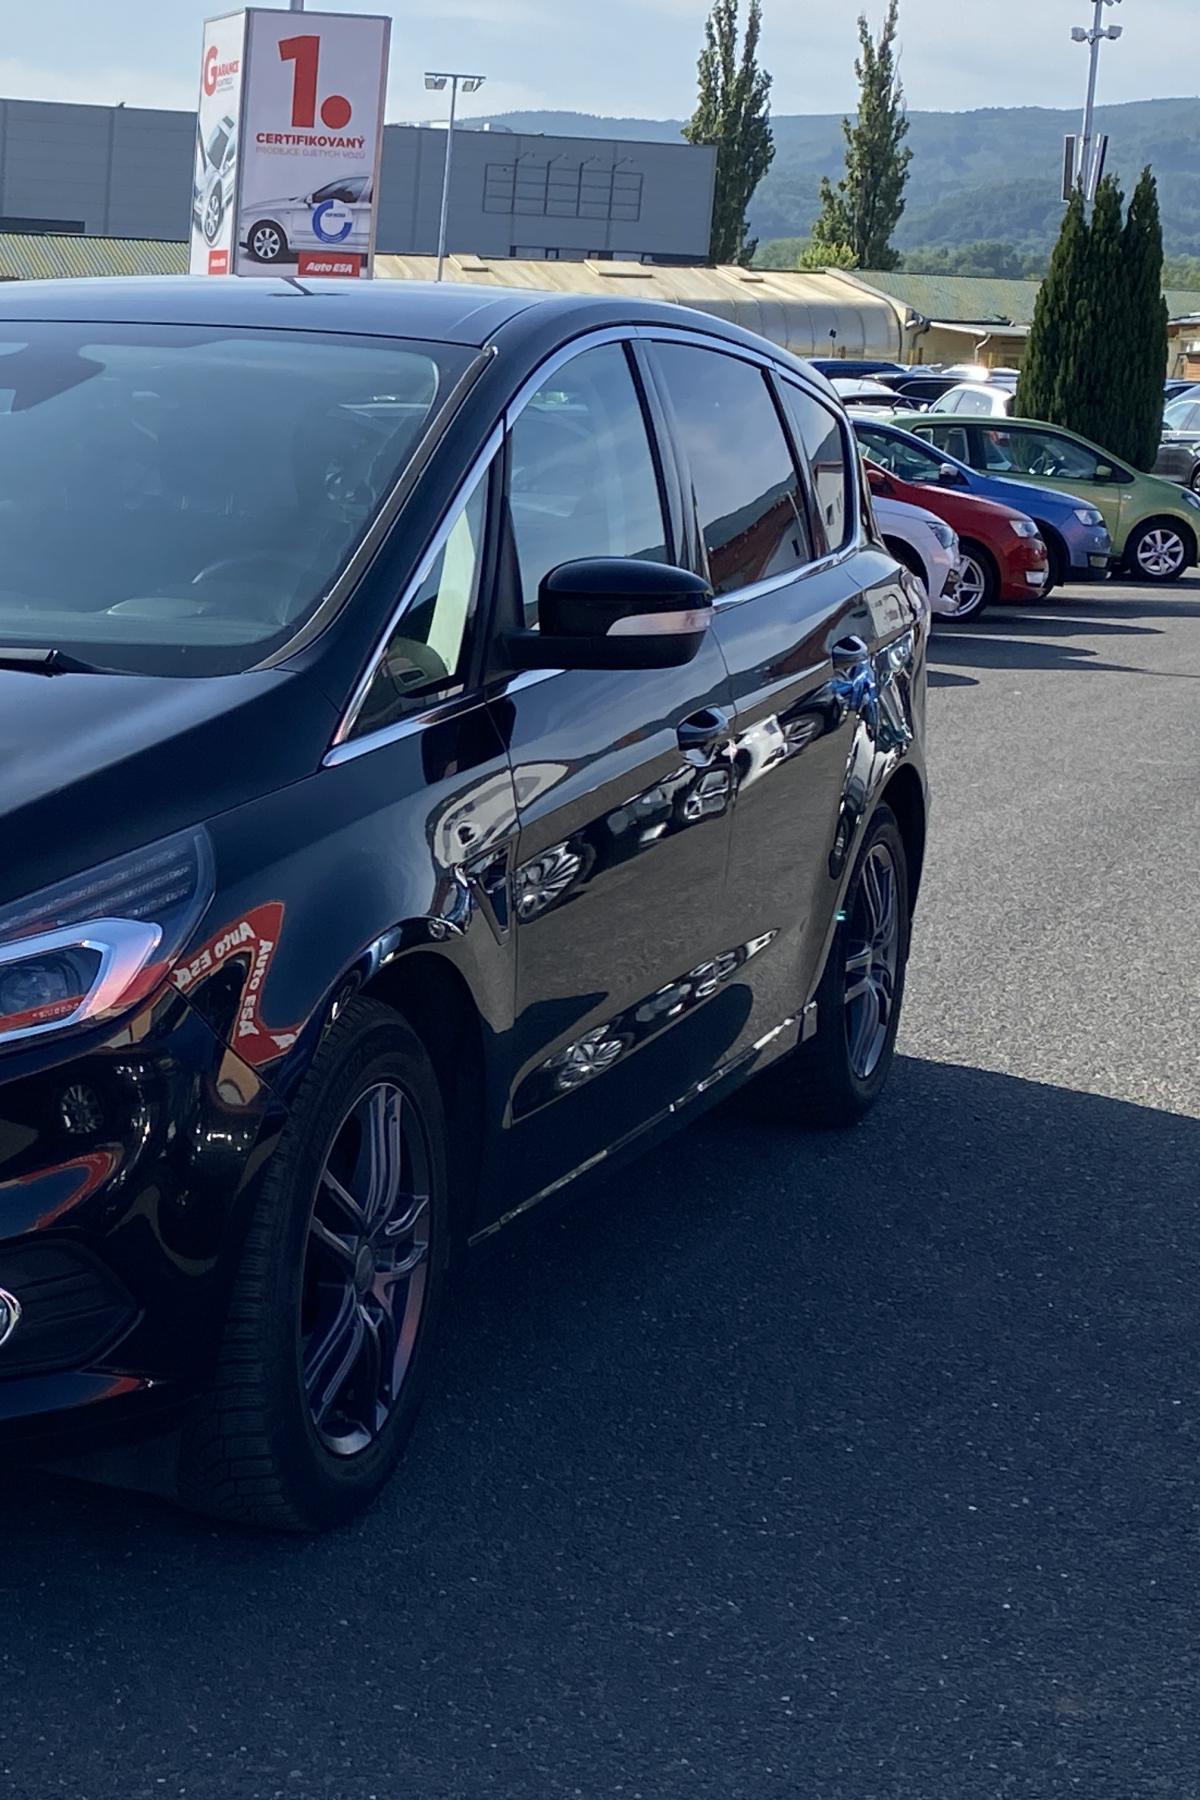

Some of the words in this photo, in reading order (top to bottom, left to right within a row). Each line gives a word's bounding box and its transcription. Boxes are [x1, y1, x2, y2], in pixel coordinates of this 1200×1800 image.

[256, 132, 365, 149] CERTIFIKOVANÝ
[305, 262, 332, 272] Auto
[332, 263, 353, 273] ESA
